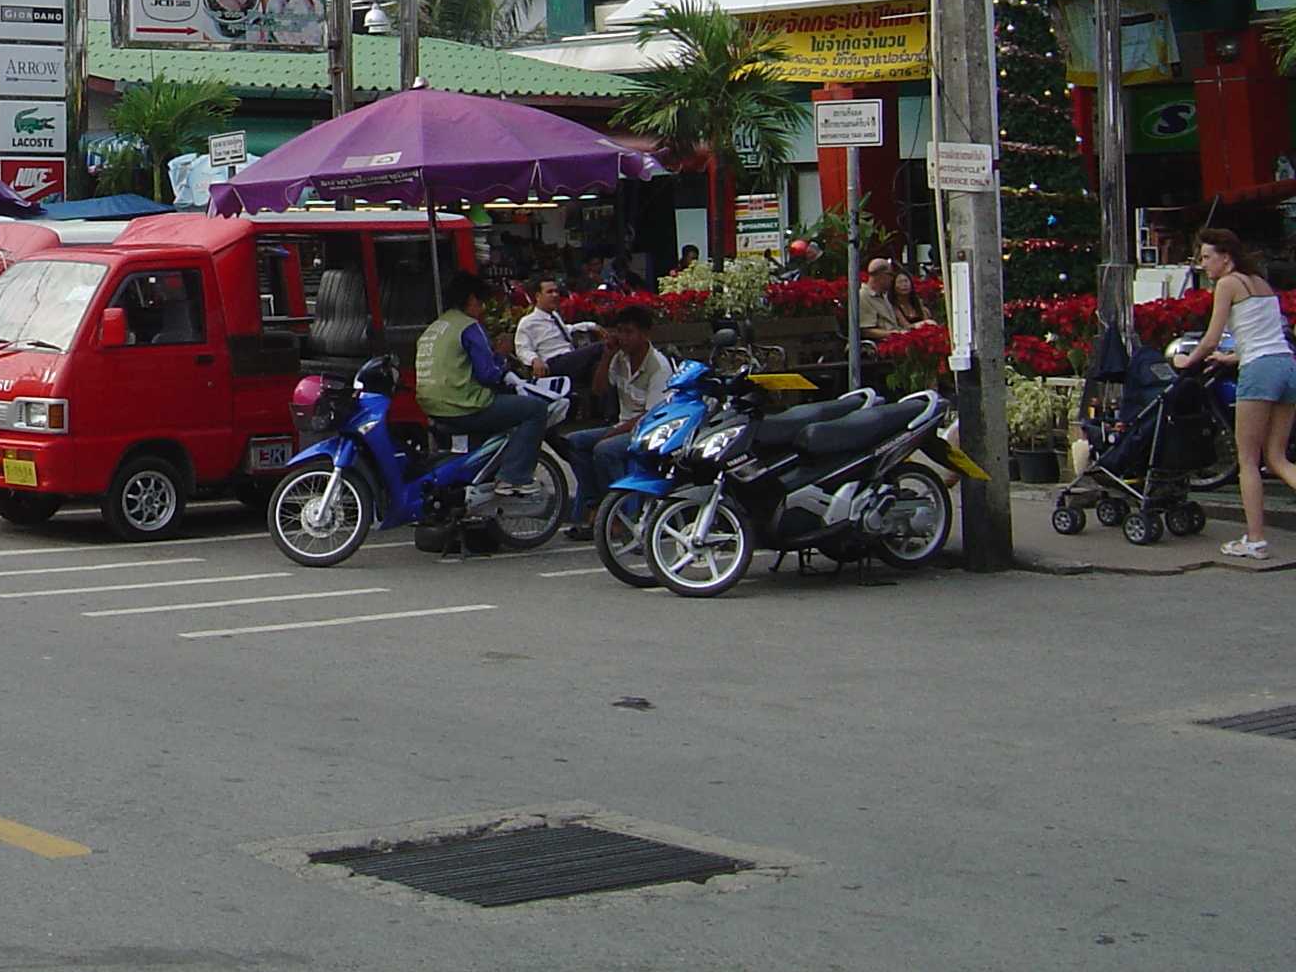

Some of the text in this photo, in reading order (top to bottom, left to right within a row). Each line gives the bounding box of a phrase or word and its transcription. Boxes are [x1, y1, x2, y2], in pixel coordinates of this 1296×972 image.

[4, 9, 62, 21] GIORDANO
[5, 59, 60, 75] ARROW
[11, 137, 54, 147] LACOSTE
[14, 167, 49, 187] NIKE
[941, 177, 968, 185] SERVICE
